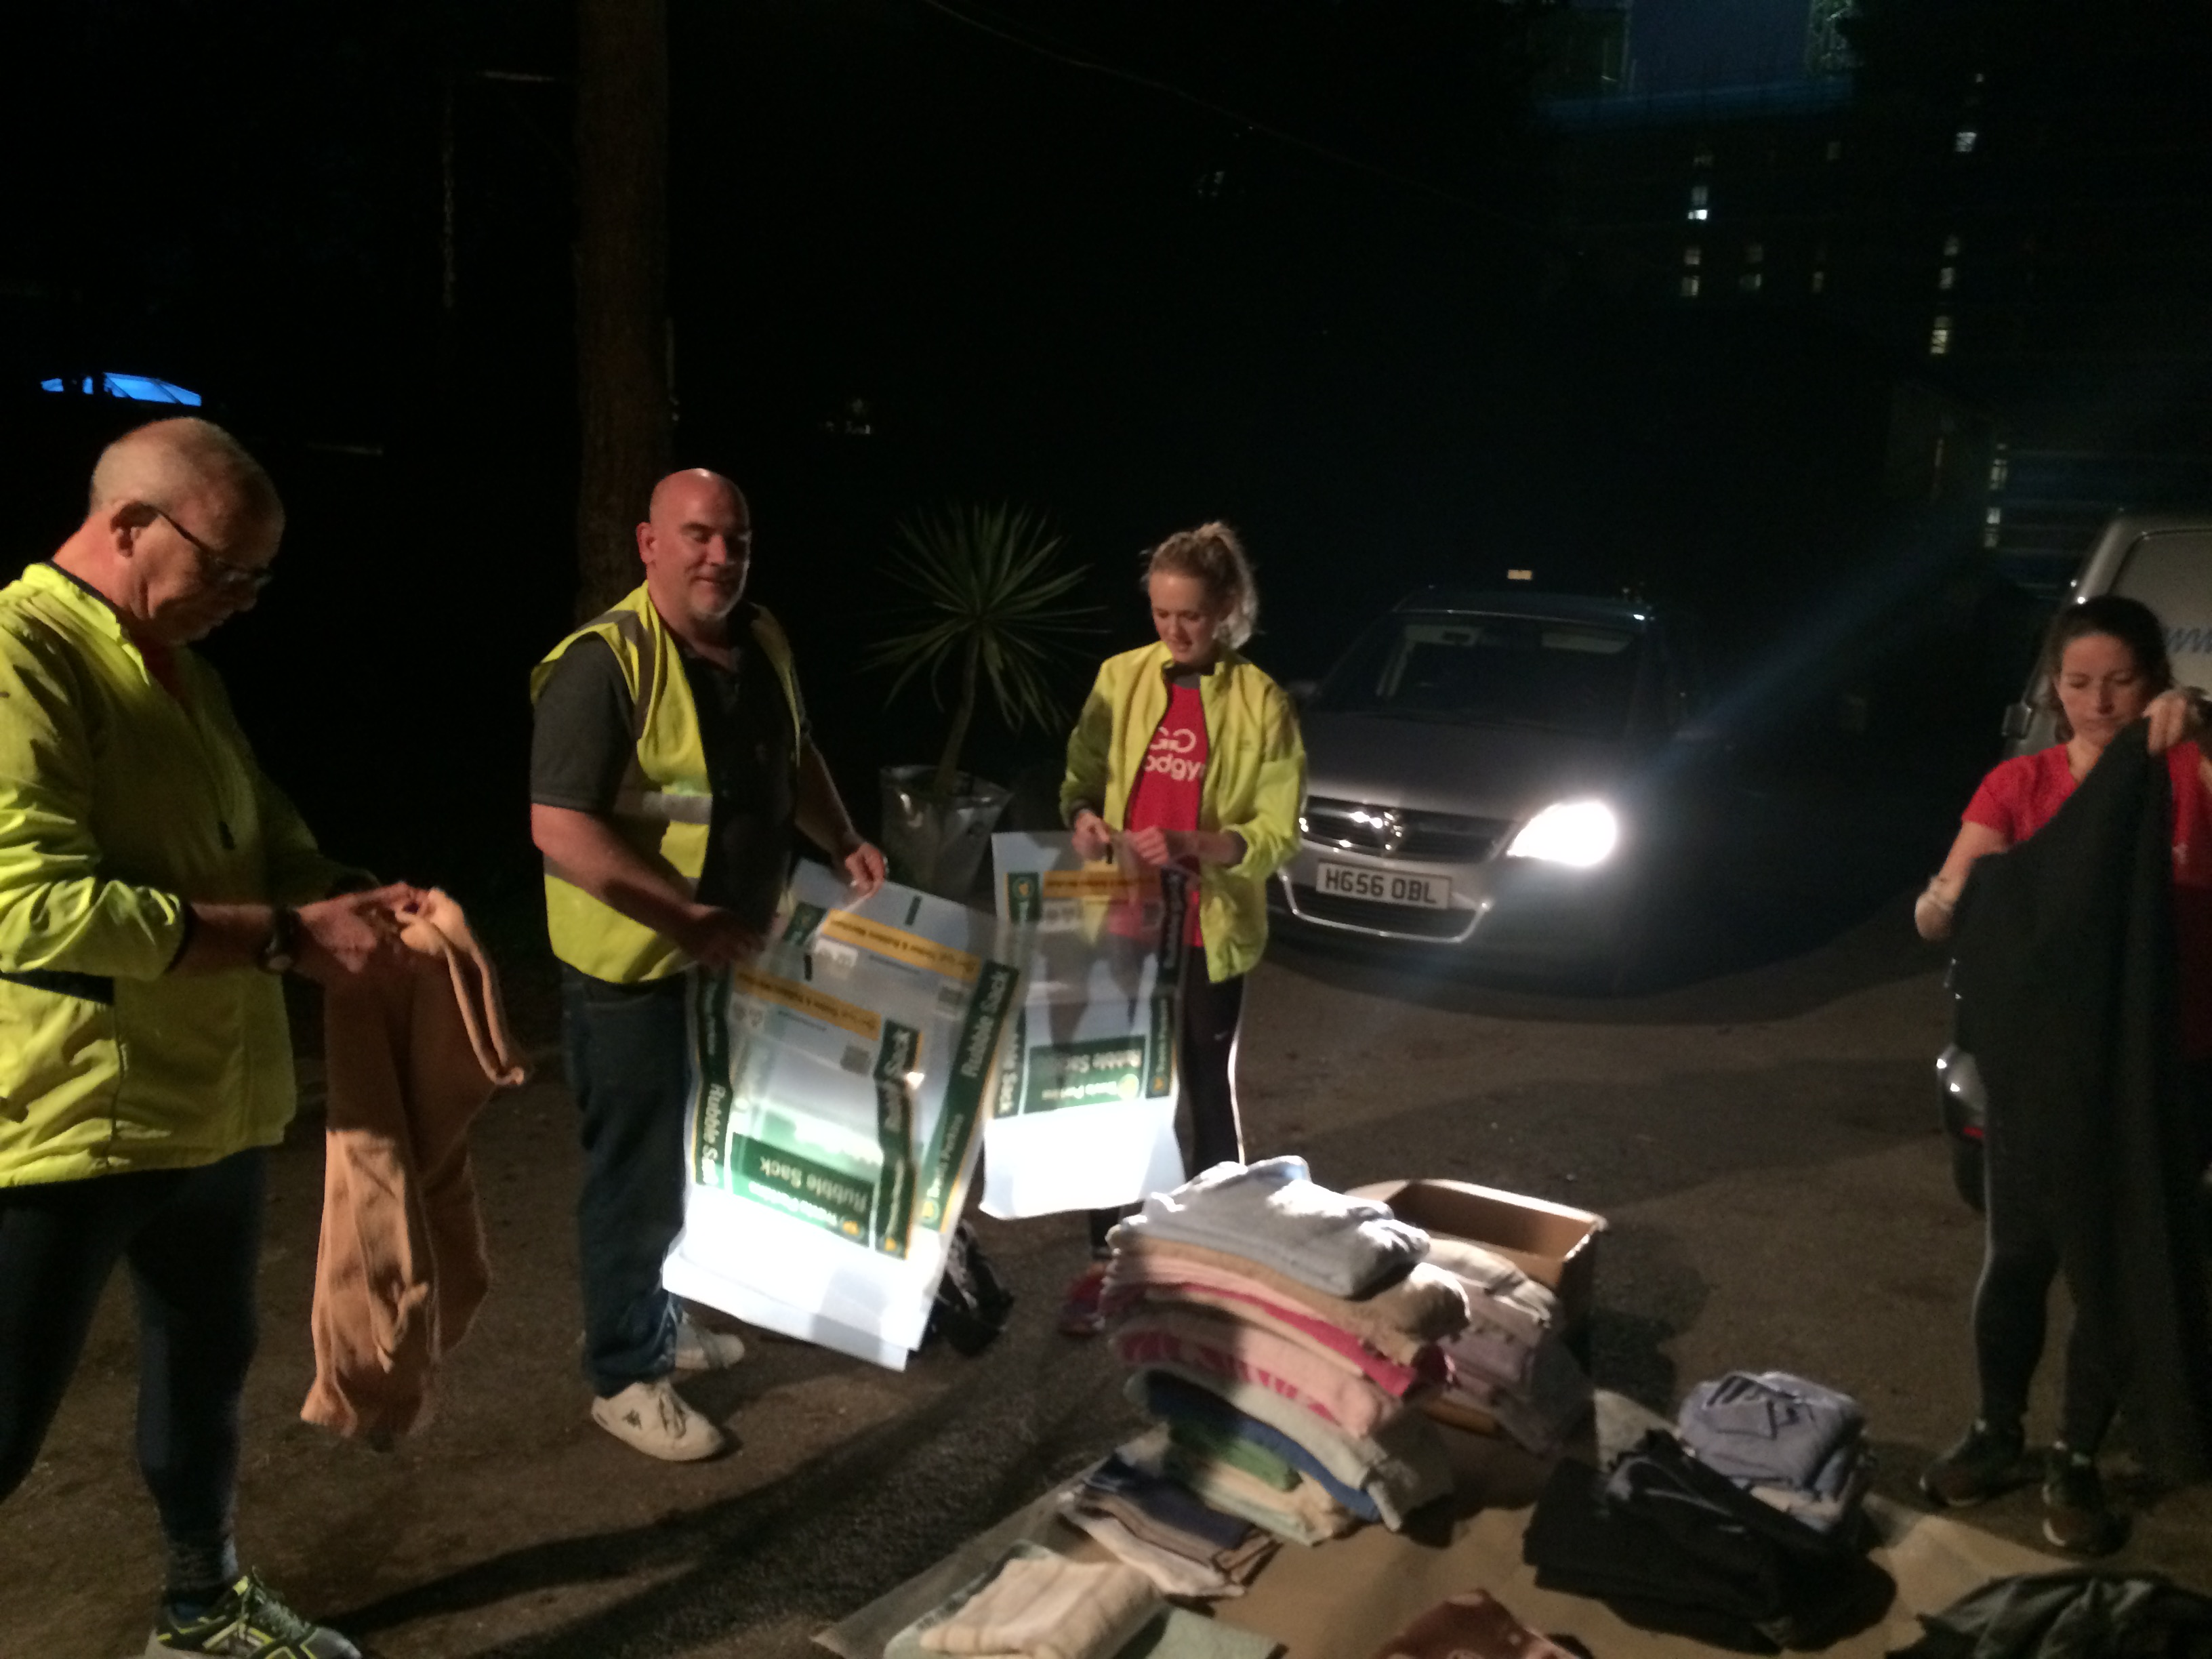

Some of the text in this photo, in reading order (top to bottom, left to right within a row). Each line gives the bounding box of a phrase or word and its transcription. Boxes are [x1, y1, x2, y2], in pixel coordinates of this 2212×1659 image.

[1325, 868, 1384, 897] HG56
[703, 1084, 726, 1144] Rubble
[760, 1155, 803, 1189] Sack
[806, 1173, 867, 1214] Rubble
